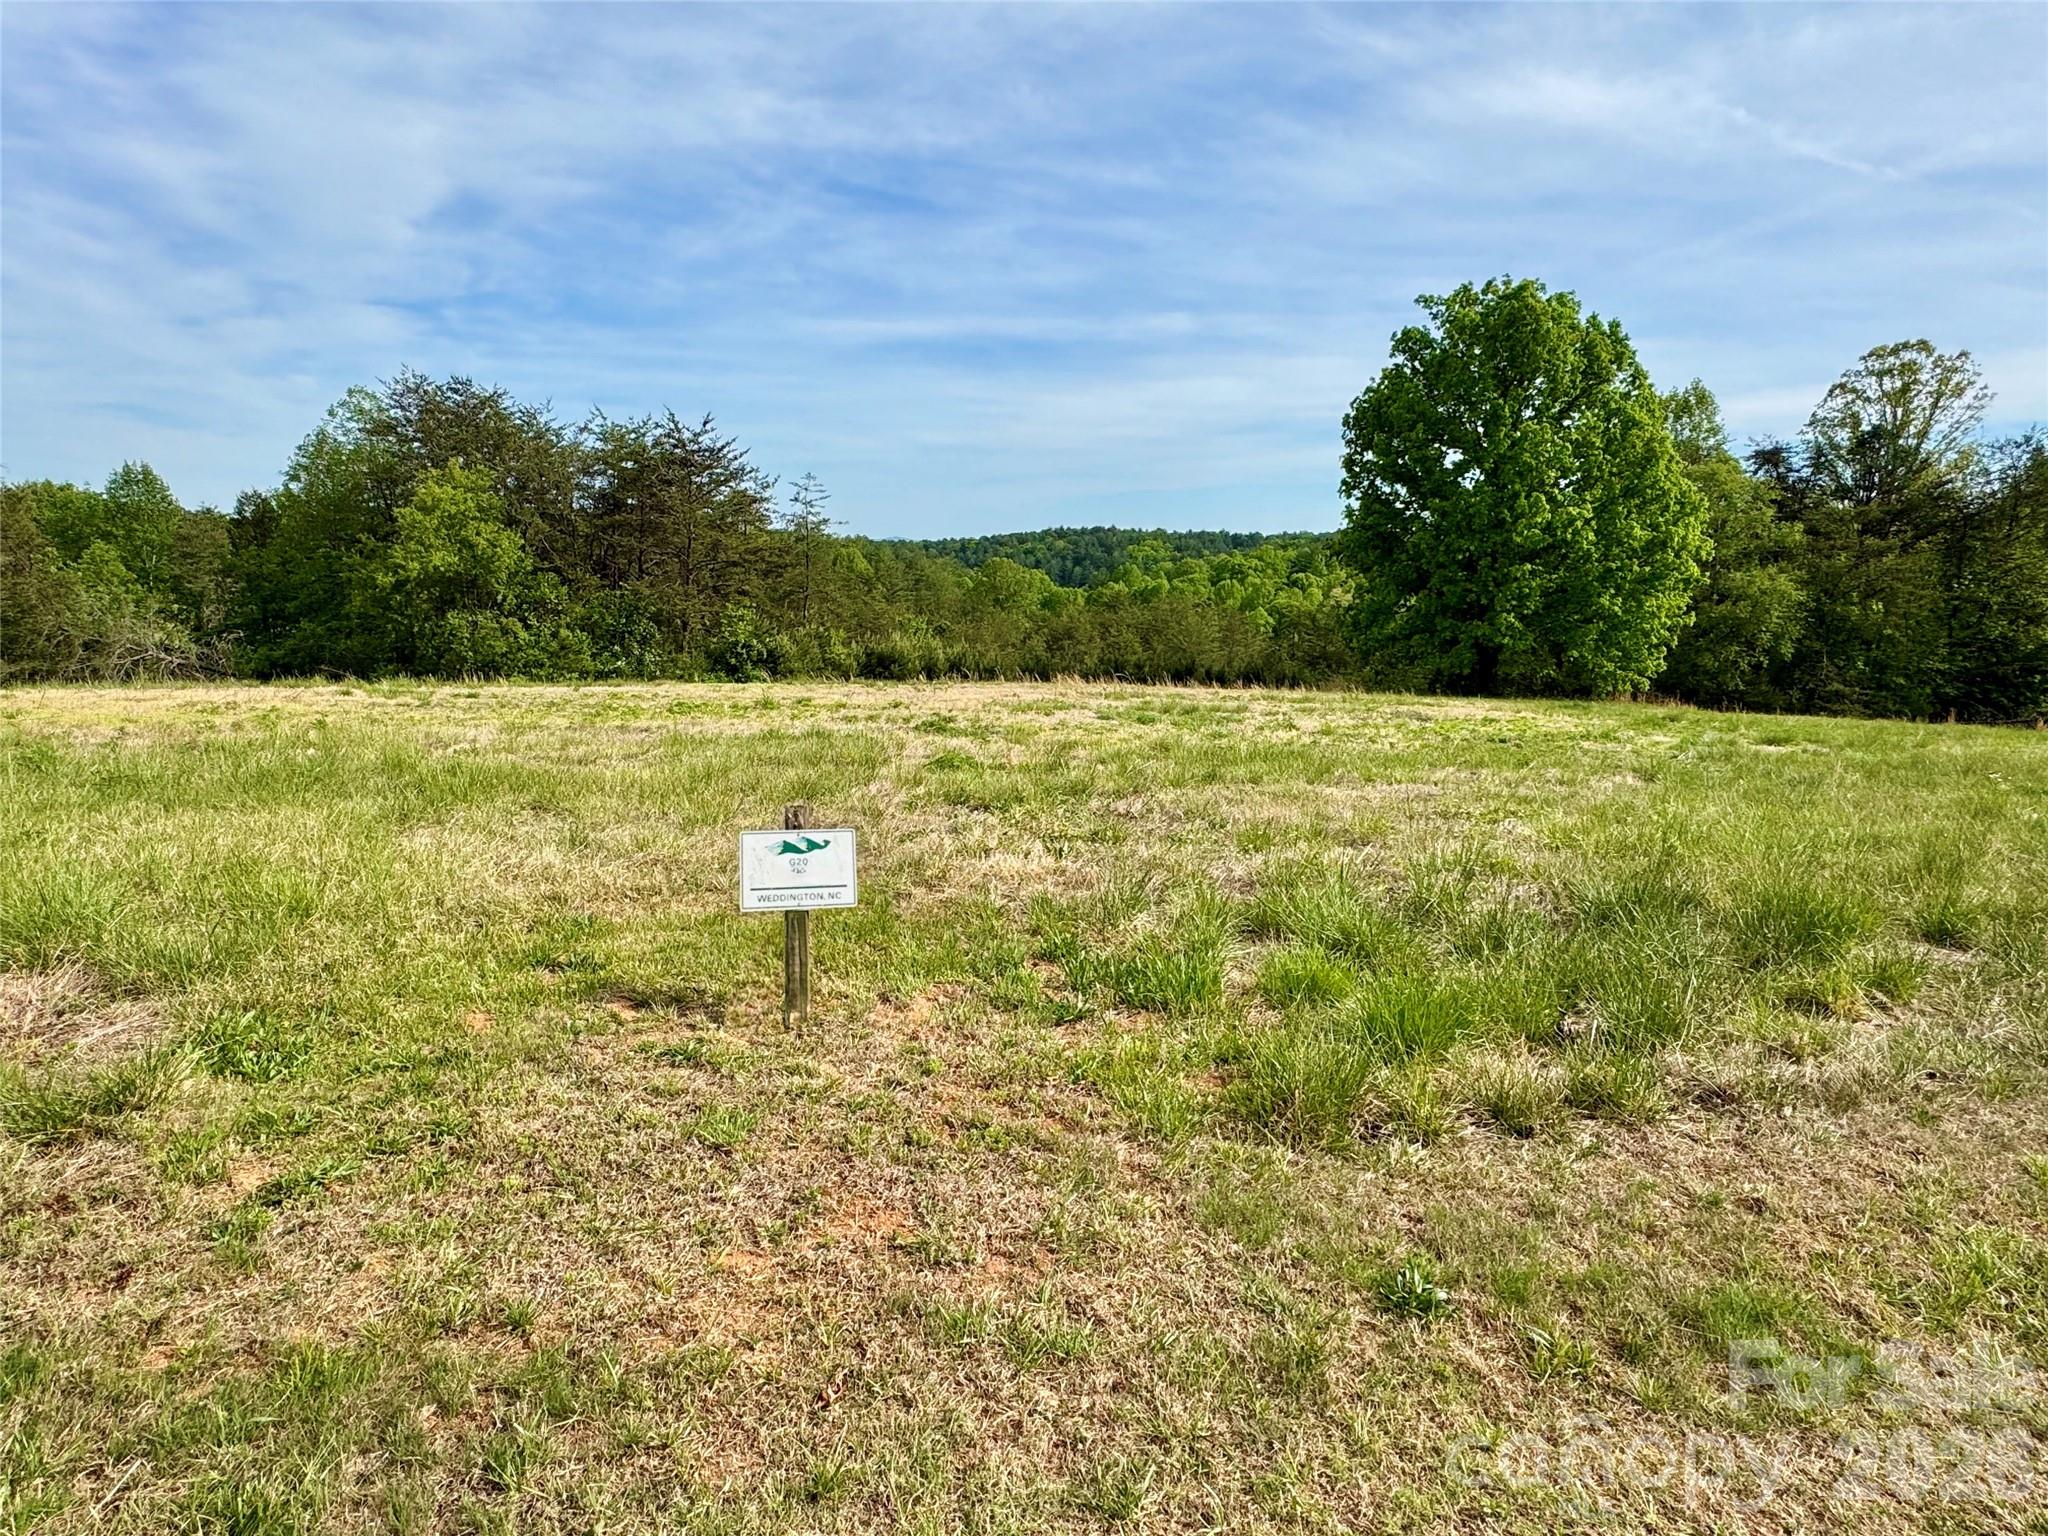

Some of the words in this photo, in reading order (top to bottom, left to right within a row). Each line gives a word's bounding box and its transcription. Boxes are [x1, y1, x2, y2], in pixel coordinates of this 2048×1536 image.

[789, 857, 809, 867] G20
[757, 892, 826, 903] WEDDINGTON,
[828, 891, 842, 900] NC
